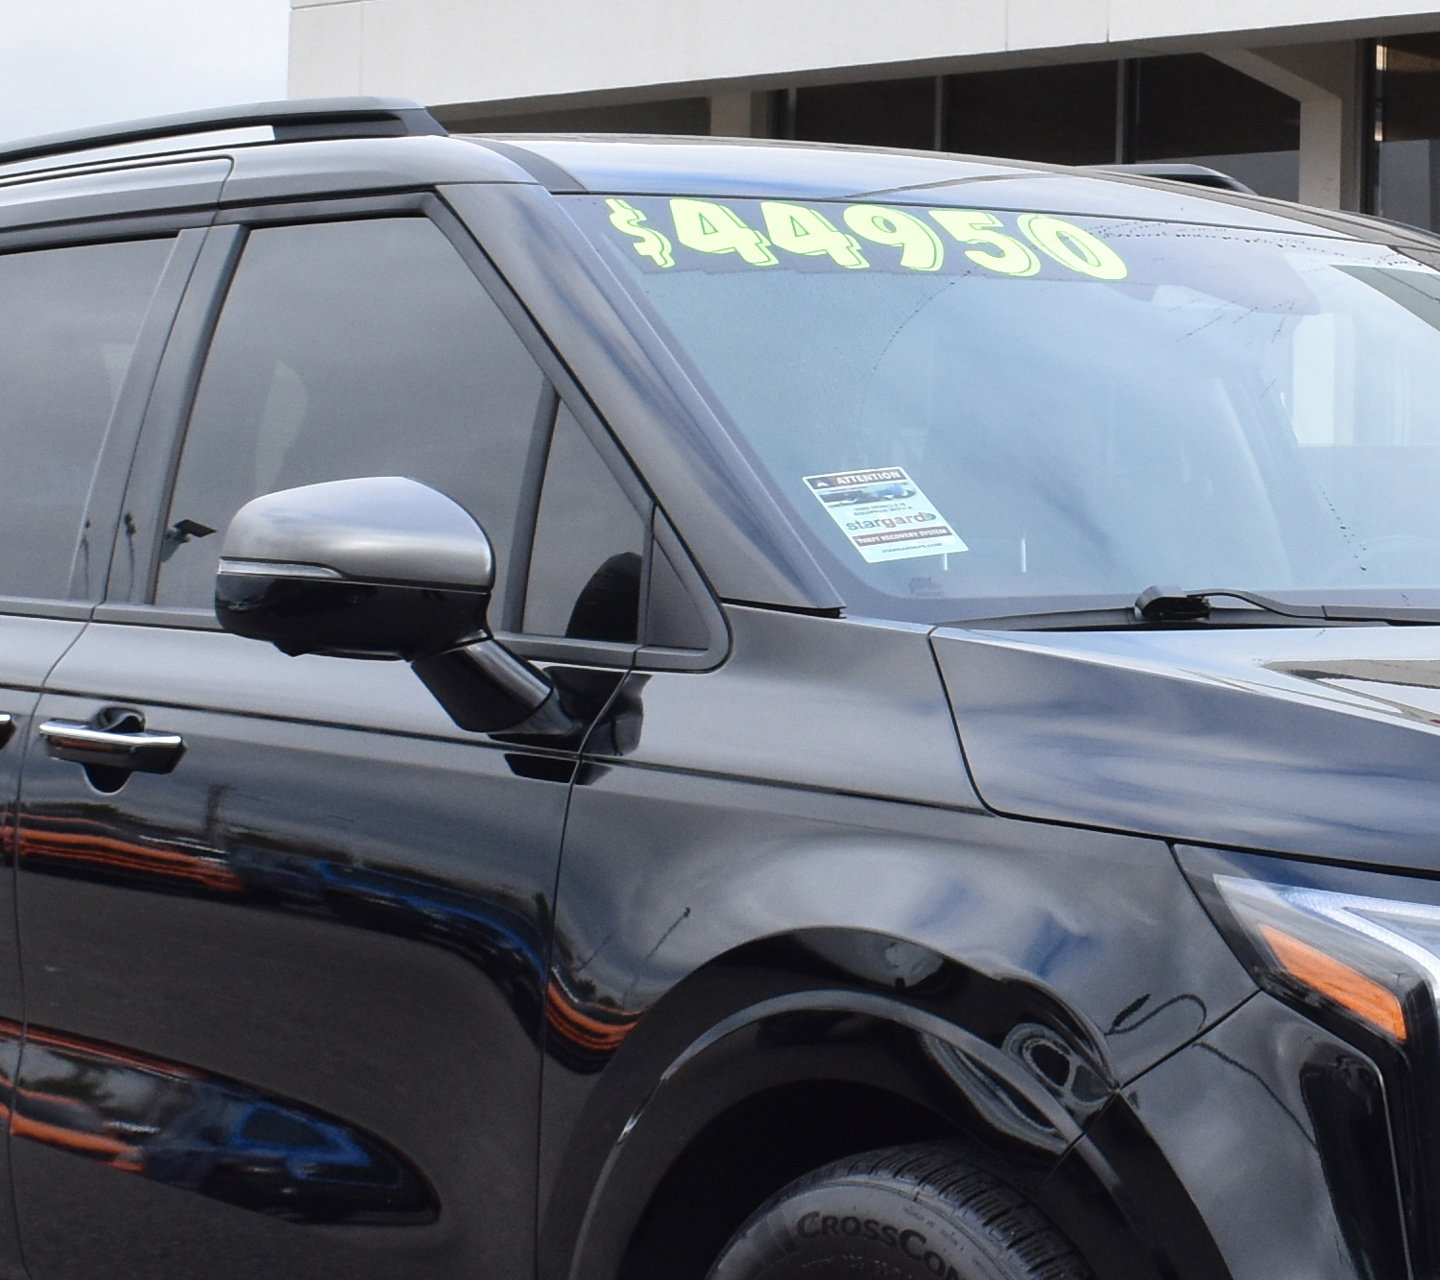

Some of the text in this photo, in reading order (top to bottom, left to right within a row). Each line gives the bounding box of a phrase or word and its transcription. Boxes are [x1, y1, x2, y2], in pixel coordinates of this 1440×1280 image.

[605, 197, 1128, 281] $44950
[836, 470, 901, 485] ATTENTION
[846, 511, 926, 531] stargard
